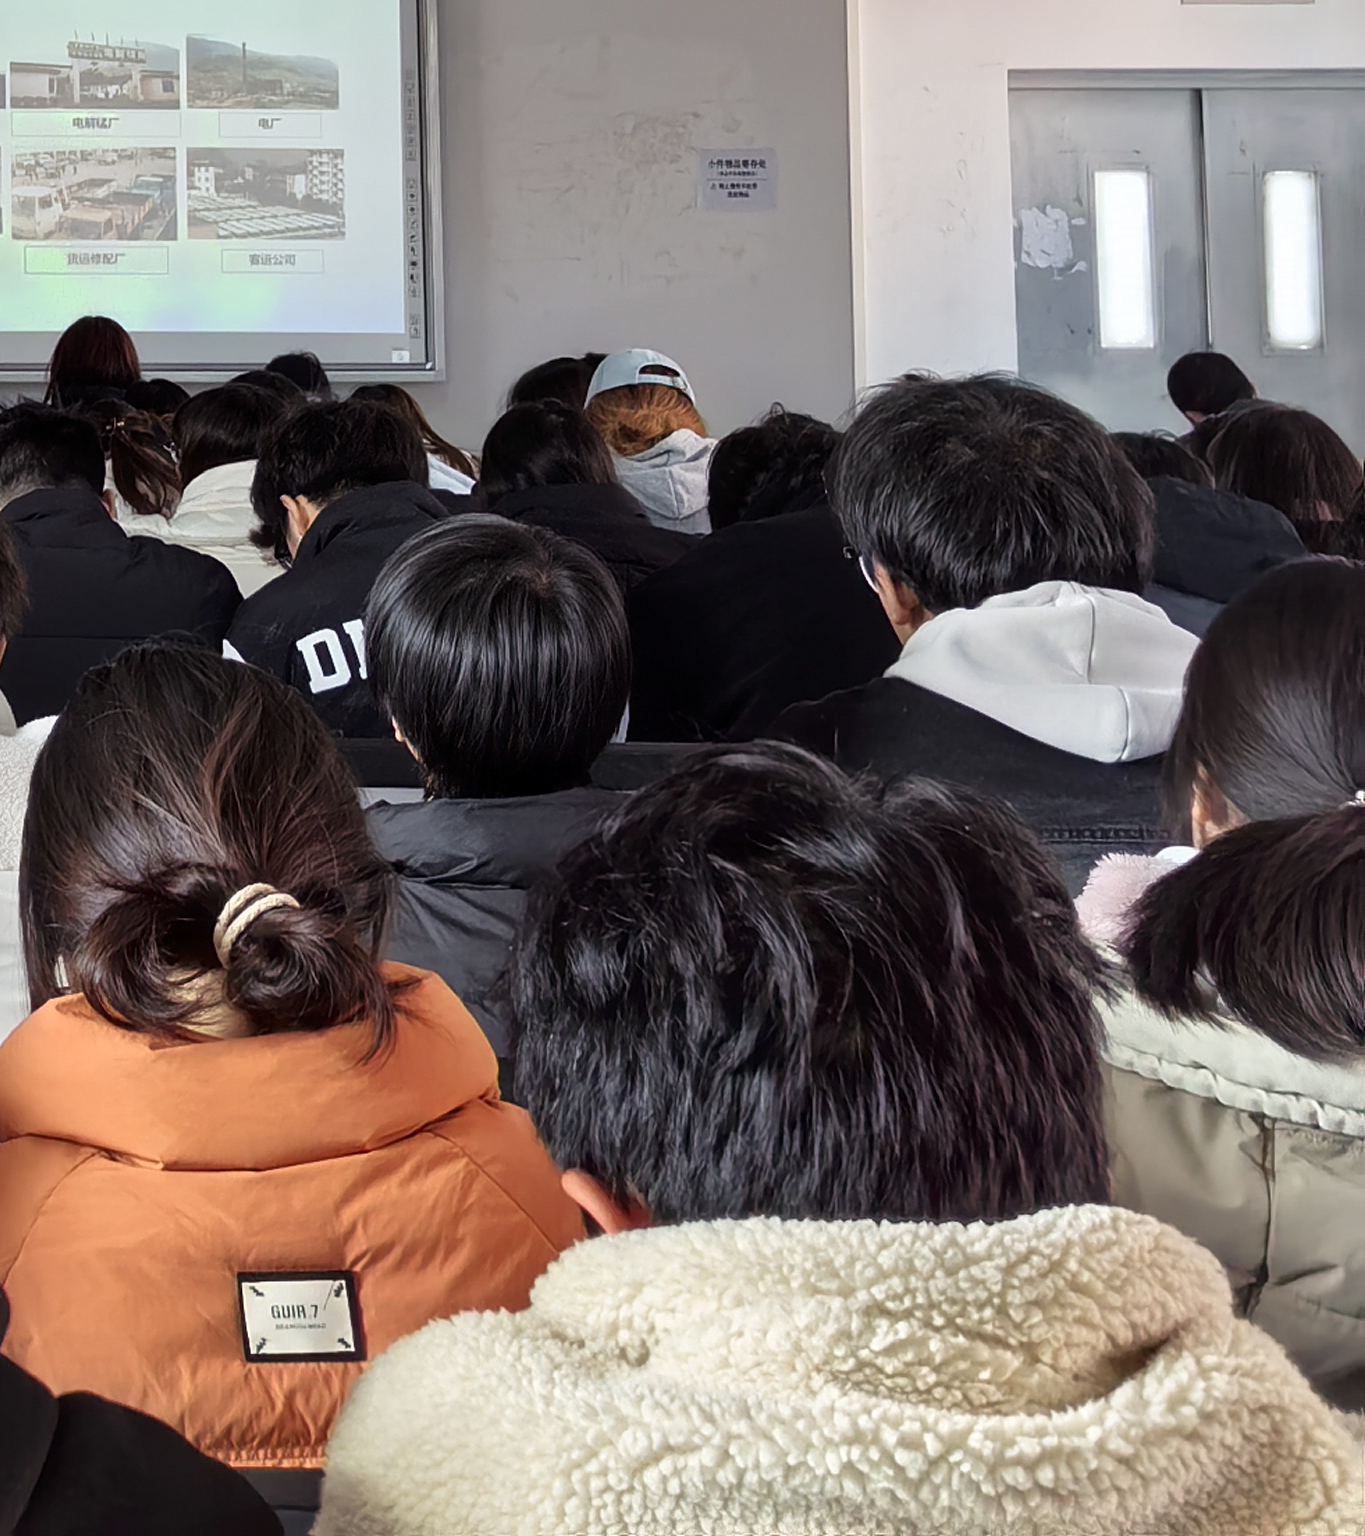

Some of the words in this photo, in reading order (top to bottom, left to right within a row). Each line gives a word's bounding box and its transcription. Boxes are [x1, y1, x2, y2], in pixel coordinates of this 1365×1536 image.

[258, 117, 283, 130] 电厂
[249, 252, 297, 266] 客运公司
